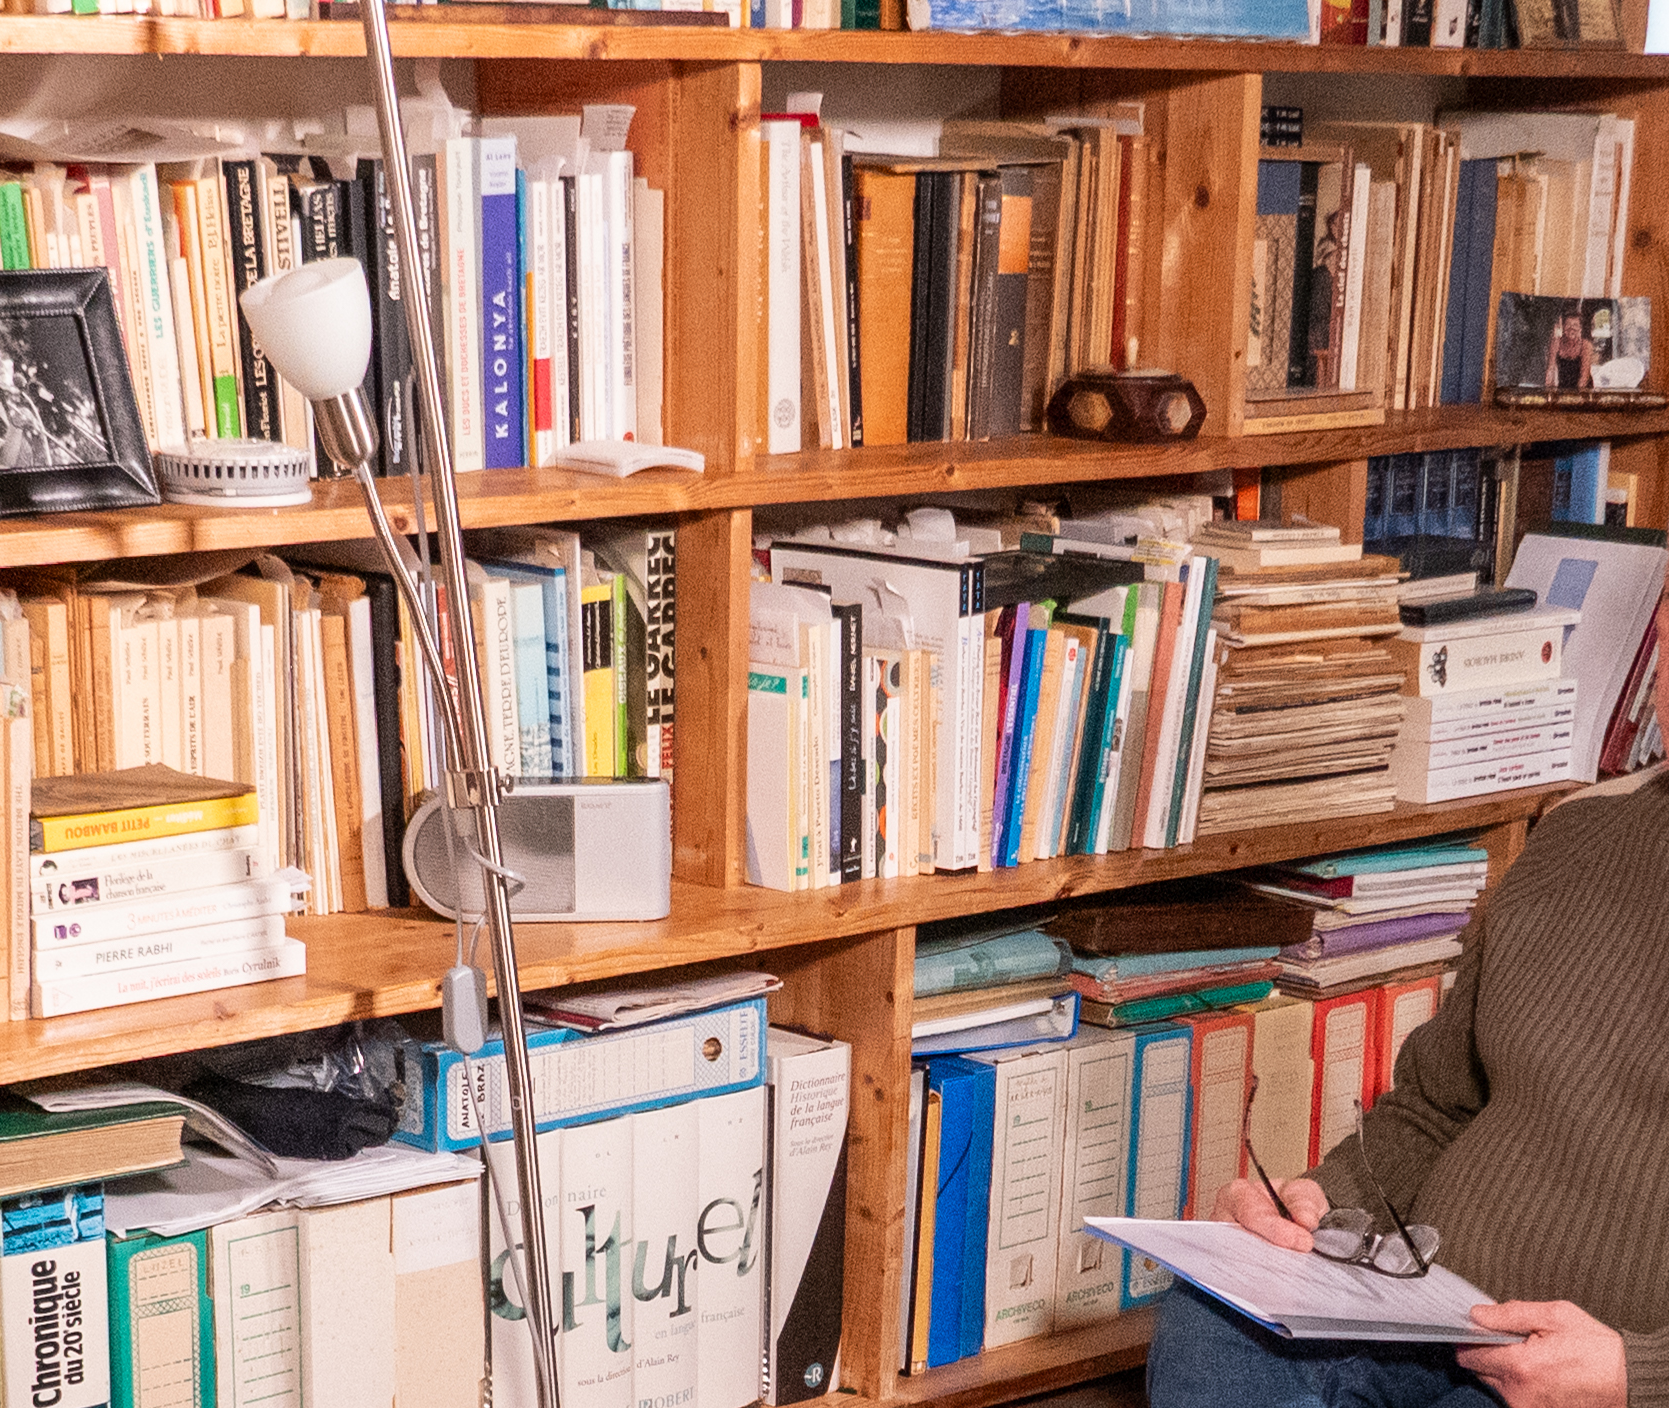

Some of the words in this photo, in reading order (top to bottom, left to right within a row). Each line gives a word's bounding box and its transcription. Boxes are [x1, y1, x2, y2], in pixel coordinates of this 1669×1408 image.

[237, 165, 258, 247] BRETAGNE
[417, 168, 428, 234] Bretagne
[270, 174, 293, 271] STIVELL
[146, 239, 161, 312] GUERRIERS
[388, 251, 402, 301] Anatole
[455, 247, 467, 298] BRETAGNE
[155, 316, 165, 340] LES
[492, 290, 509, 440] KALONYA
[496, 595, 512, 675] D'EUROPE
[617, 644, 627, 705] OISEAUX
[500, 676, 514, 728] TERRE
[64, 820, 120, 841] BAMBOU
[120, 816, 151, 833] PETIT
[135, 872, 147, 885] de
[126, 912, 138, 931] 3
[137, 909, 175, 927] MINUTES
[182, 903, 218, 919] MÉDITER
[95, 948, 134, 965] PIERRE
[137, 943, 174, 958] RABHI
[117, 981, 130, 994] La
[181, 972, 195, 985] des
[195, 968, 222, 982] soleils
[241, 957, 283, 975] Cyrulnik
[738, 1010, 750, 1062] ESSELTE
[476, 1063, 487, 1105] BRAZ
[789, 1071, 847, 1094] Dictionnaire
[789, 1085, 840, 1105] Historique
[789, 1110, 835, 1131] française
[790, 1103, 803, 1116] de
[804, 1101, 814, 1114] la
[814, 1095, 845, 1115] langue
[789, 1144, 819, 1159] d'Alain
[818, 1142, 834, 1156] Rey
[62, 1269, 85, 1328] siècle
[239, 1283, 251, 1295] 19
[1065, 1280, 1115, 1305] ARCHIVECO
[654, 1328, 668, 1340] en
[669, 1319, 698, 1340] langue
[700, 1306, 746, 1325] française
[995, 1298, 1046, 1323] ARCHIVECO
[63, 1357, 85, 1387] du
[576, 1378, 596, 1388] sous
[597, 1373, 605, 1384] la
[635, 1357, 666, 1370] d'Alain
[666, 1353, 680, 1364] Rey
